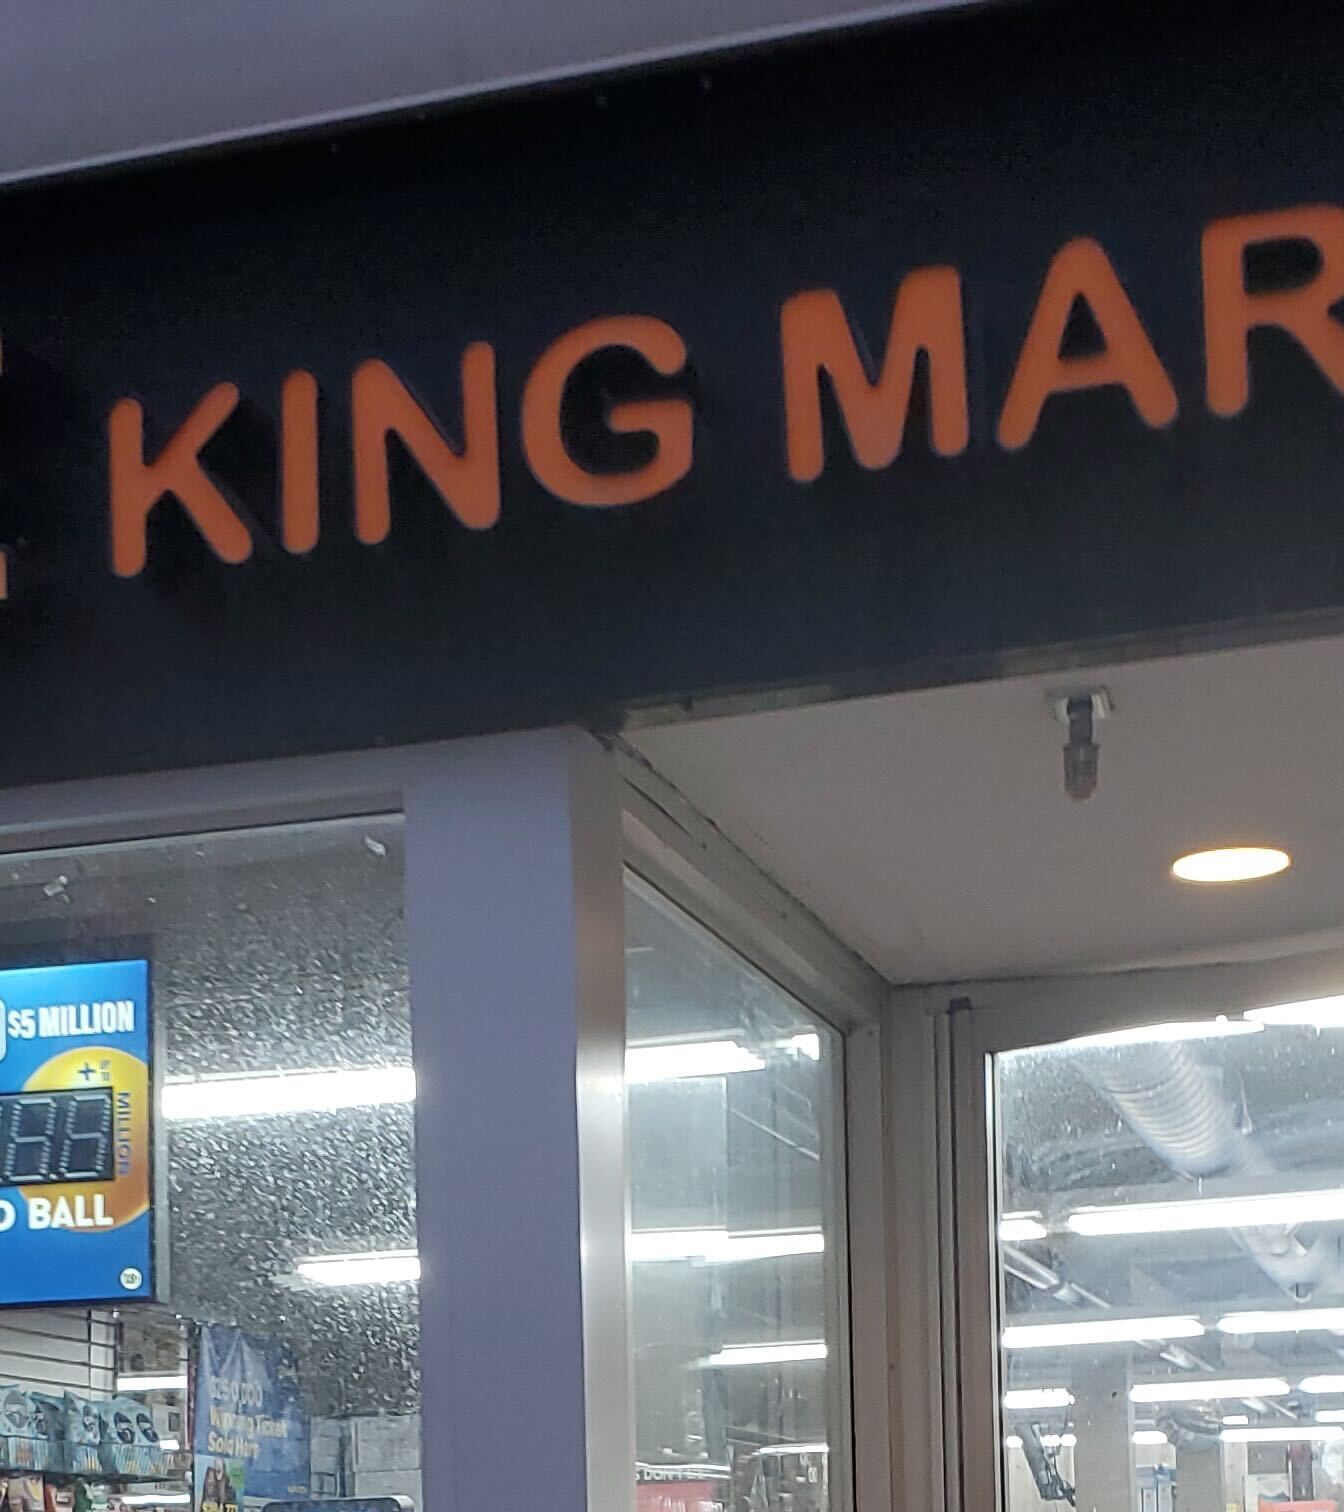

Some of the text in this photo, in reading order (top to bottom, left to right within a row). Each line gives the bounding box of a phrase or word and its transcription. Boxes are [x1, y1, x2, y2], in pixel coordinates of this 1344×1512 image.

[108, 314, 695, 578] KING
[8, 1000, 135, 1040] $5 MILLION
[27, 1193, 114, 1230] BALL
